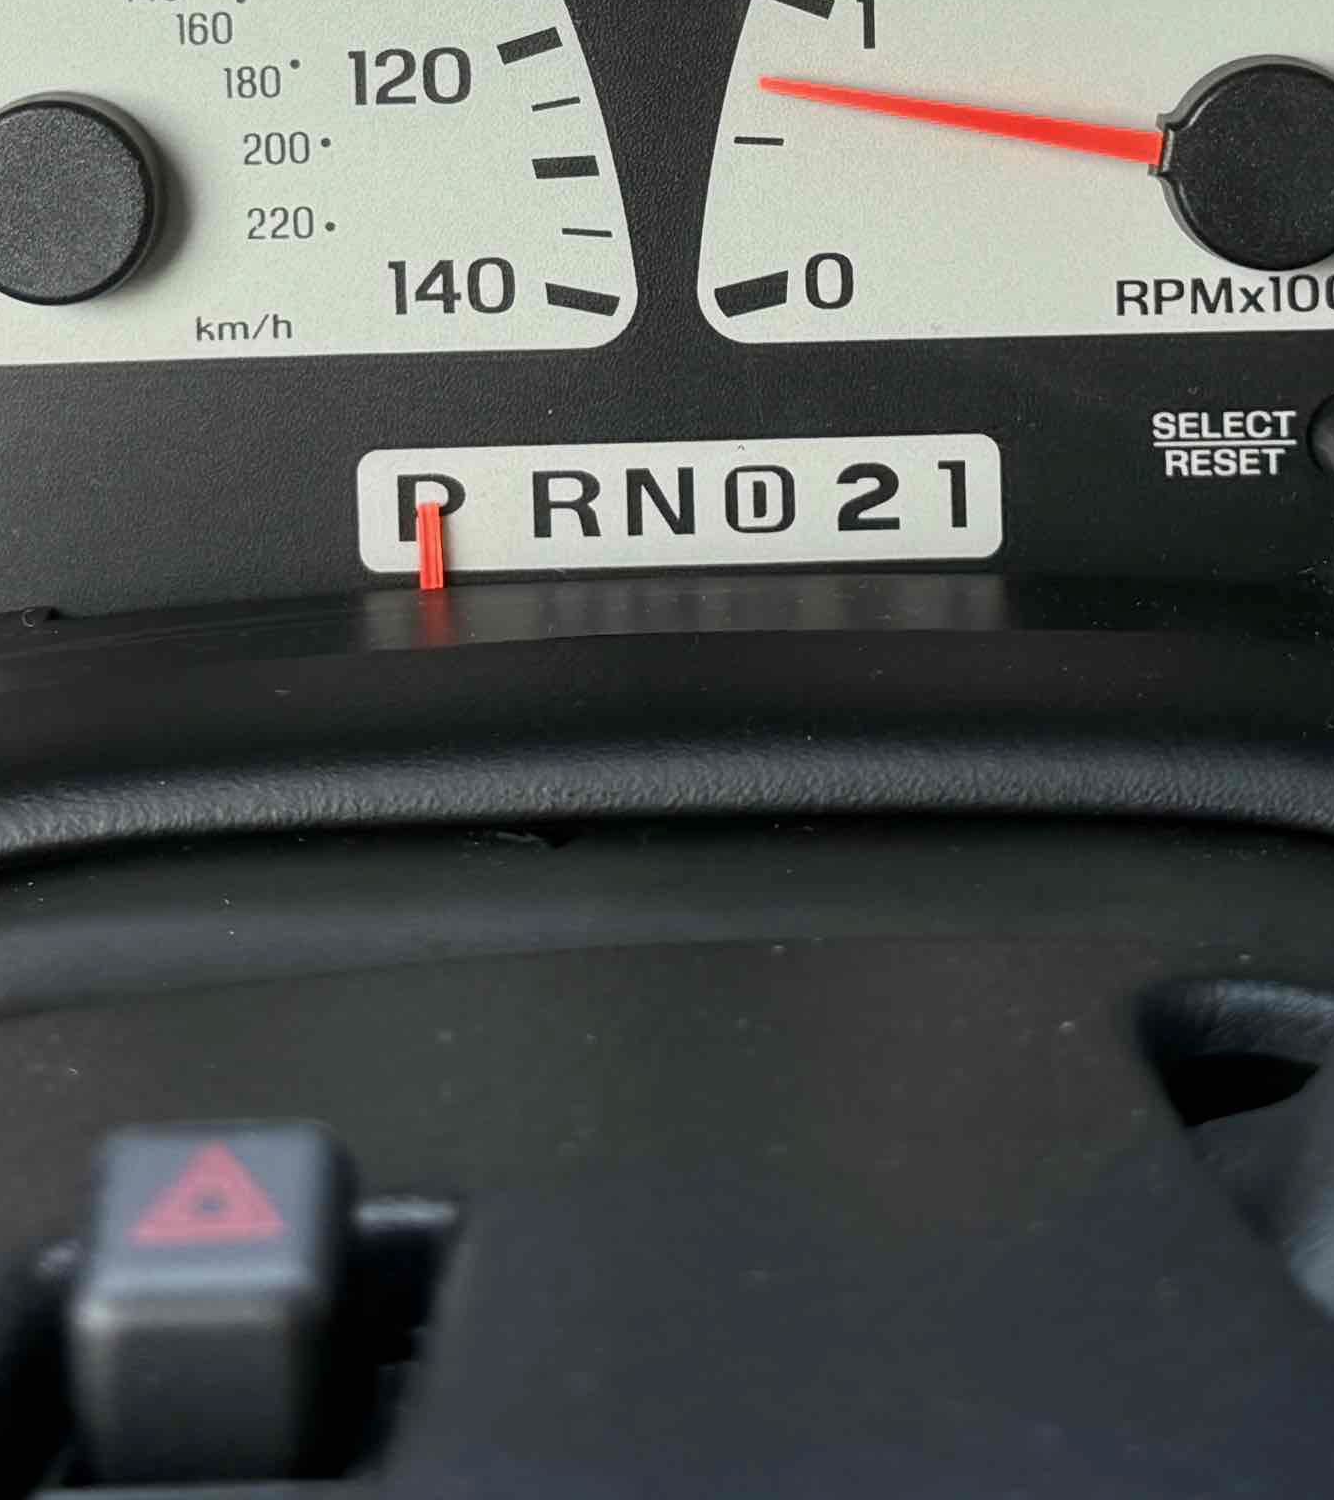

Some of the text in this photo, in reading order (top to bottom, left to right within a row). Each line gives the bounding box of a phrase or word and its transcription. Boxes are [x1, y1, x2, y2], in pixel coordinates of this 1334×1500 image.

[176, 12, 232, 45] 160
[224, 66, 280, 98] 180
[348, 47, 471, 105] 120
[244, 132, 309, 165] 200
[248, 206, 313, 239] 220
[388, 257, 515, 315] 140
[805, 253, 853, 309] 0
[197, 314, 292, 341] km/h
[1152, 411, 1297, 439] SELECT
[1165, 449, 1285, 476] RESET
[398, 473, 466, 542] P
[533, 471, 601, 538] R
[626, 467, 695, 536] N
[837, 463, 900, 531] 2
[938, 461, 967, 527] 1
